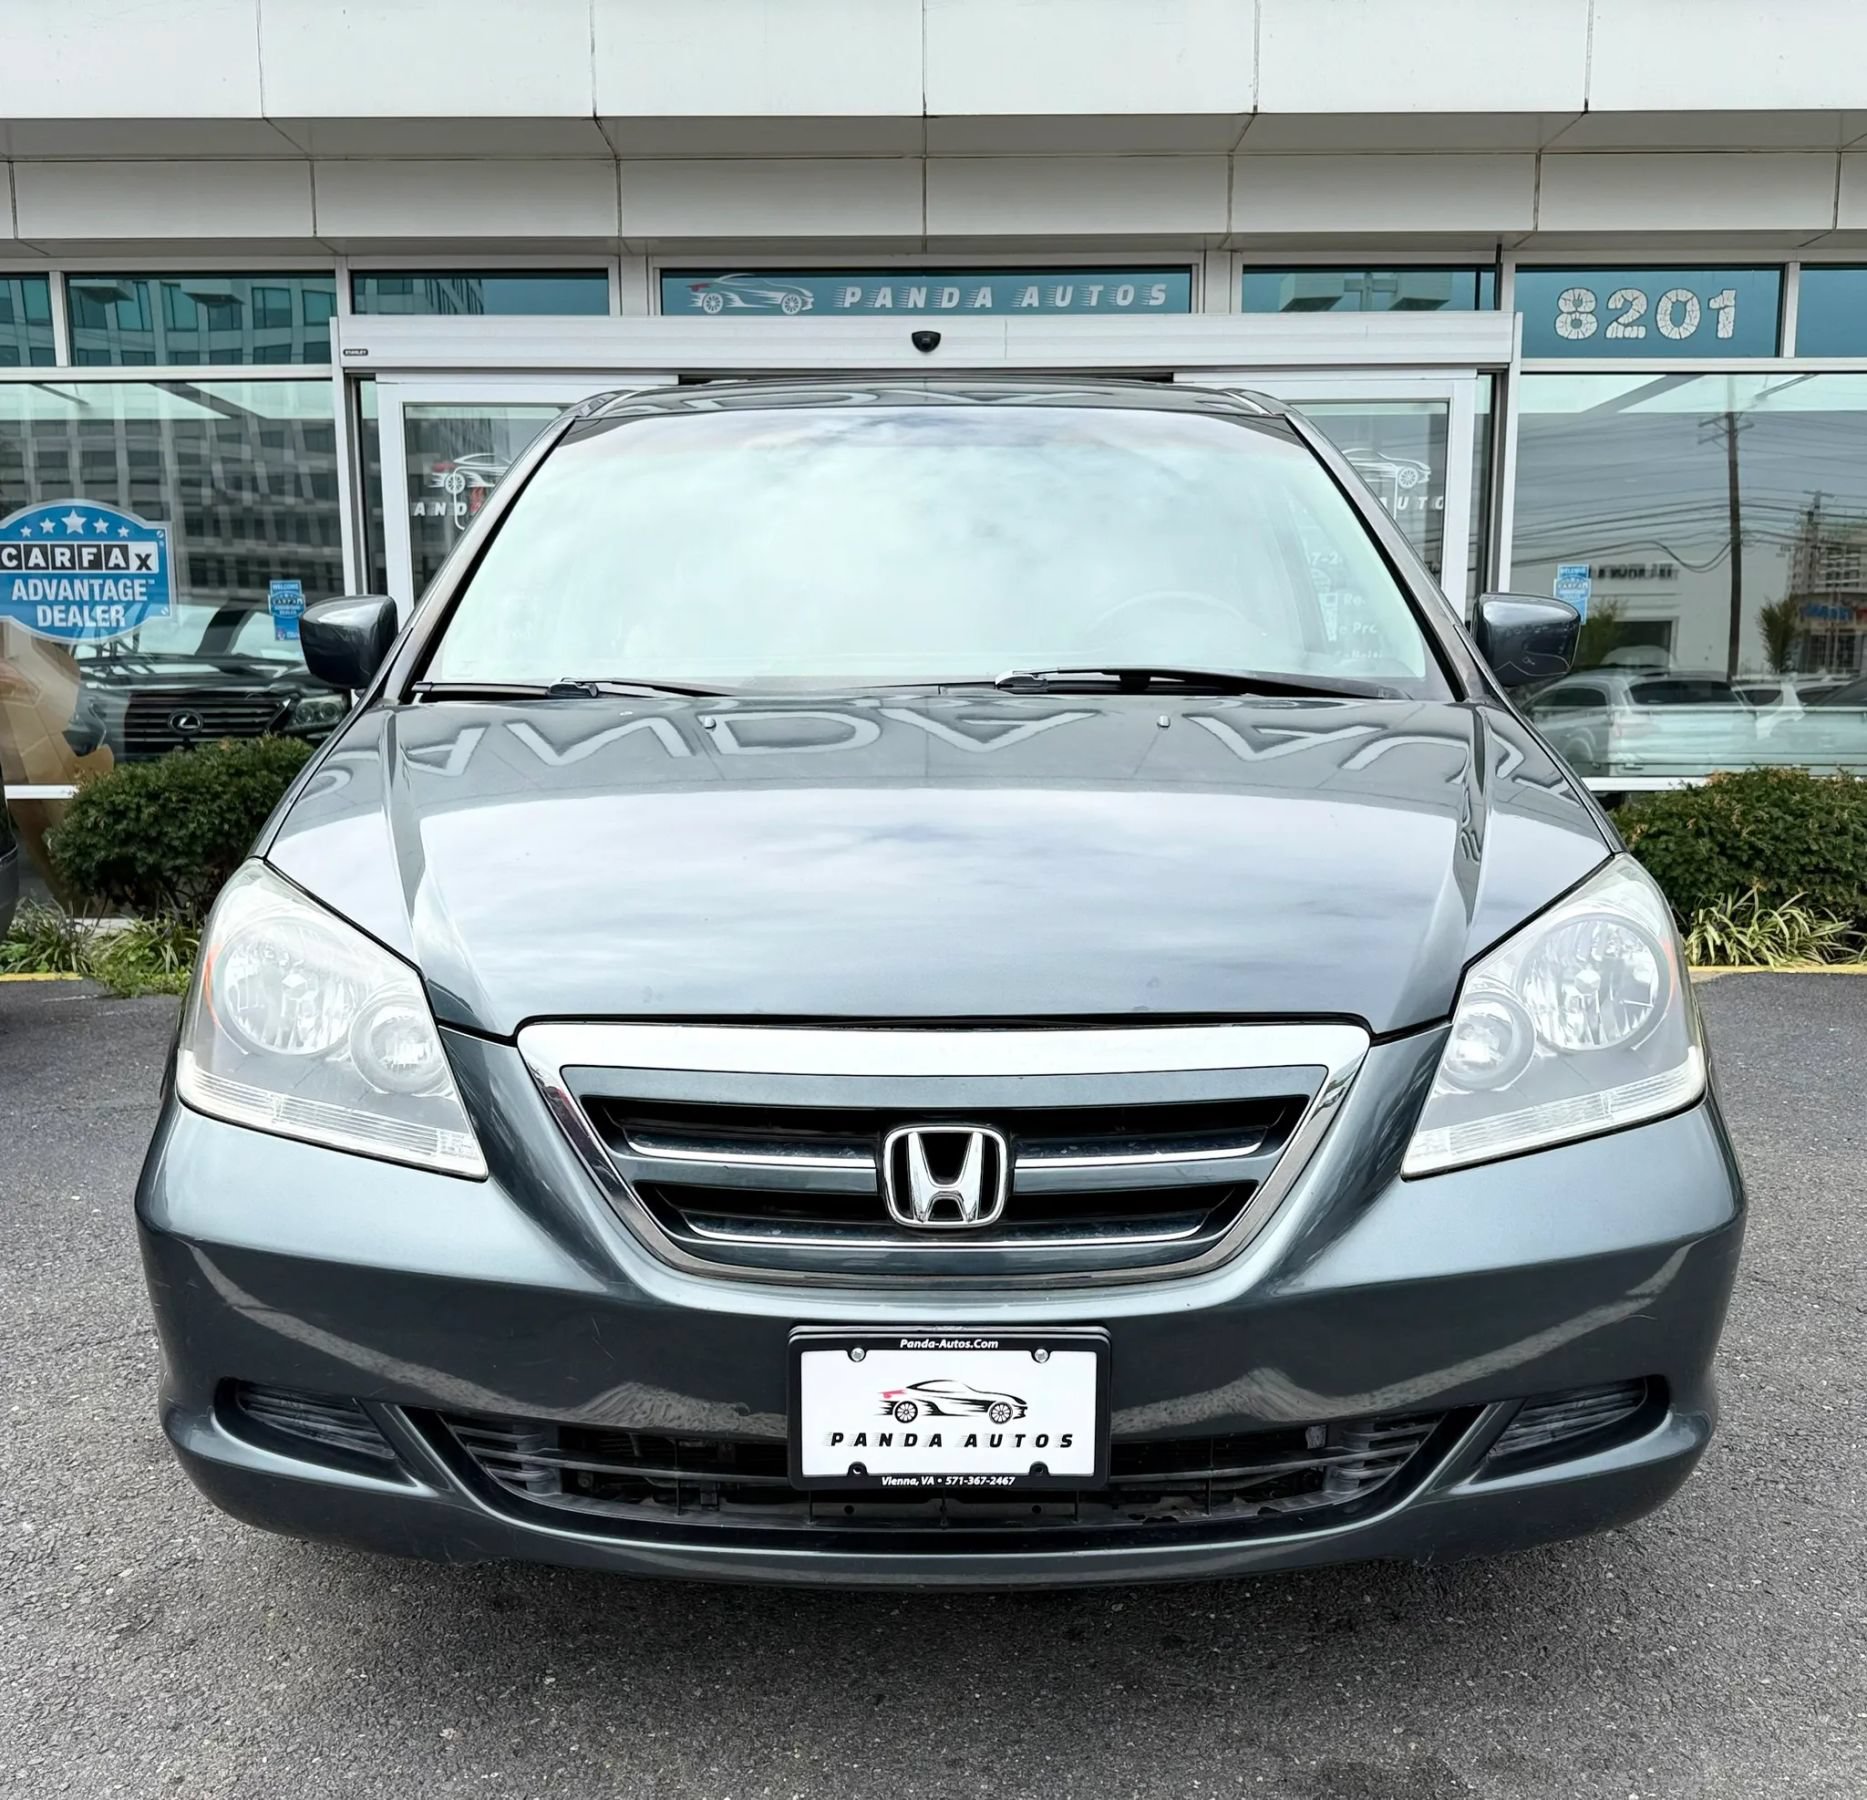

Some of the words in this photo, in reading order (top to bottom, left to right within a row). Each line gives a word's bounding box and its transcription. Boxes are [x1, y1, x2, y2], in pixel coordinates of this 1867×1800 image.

[838, 286, 993, 308] PANDA
[1016, 284, 1167, 306] AUTOS
[1554, 288, 1737, 339] 8201
[1, 546, 153, 571] CARFAX
[11, 578, 149, 601] ADVANTAGE
[36, 604, 126, 628] DEALER
[899, 1338, 999, 1350] Panda-Autos.Com
[829, 1432, 943, 1448] PANDA
[963, 1433, 1074, 1448] AUTOS
[881, 1476, 919, 1487] Vienna,
[921, 1476, 936, 1486] VA
[945, 1476, 1016, 1486] 571-367-2467
